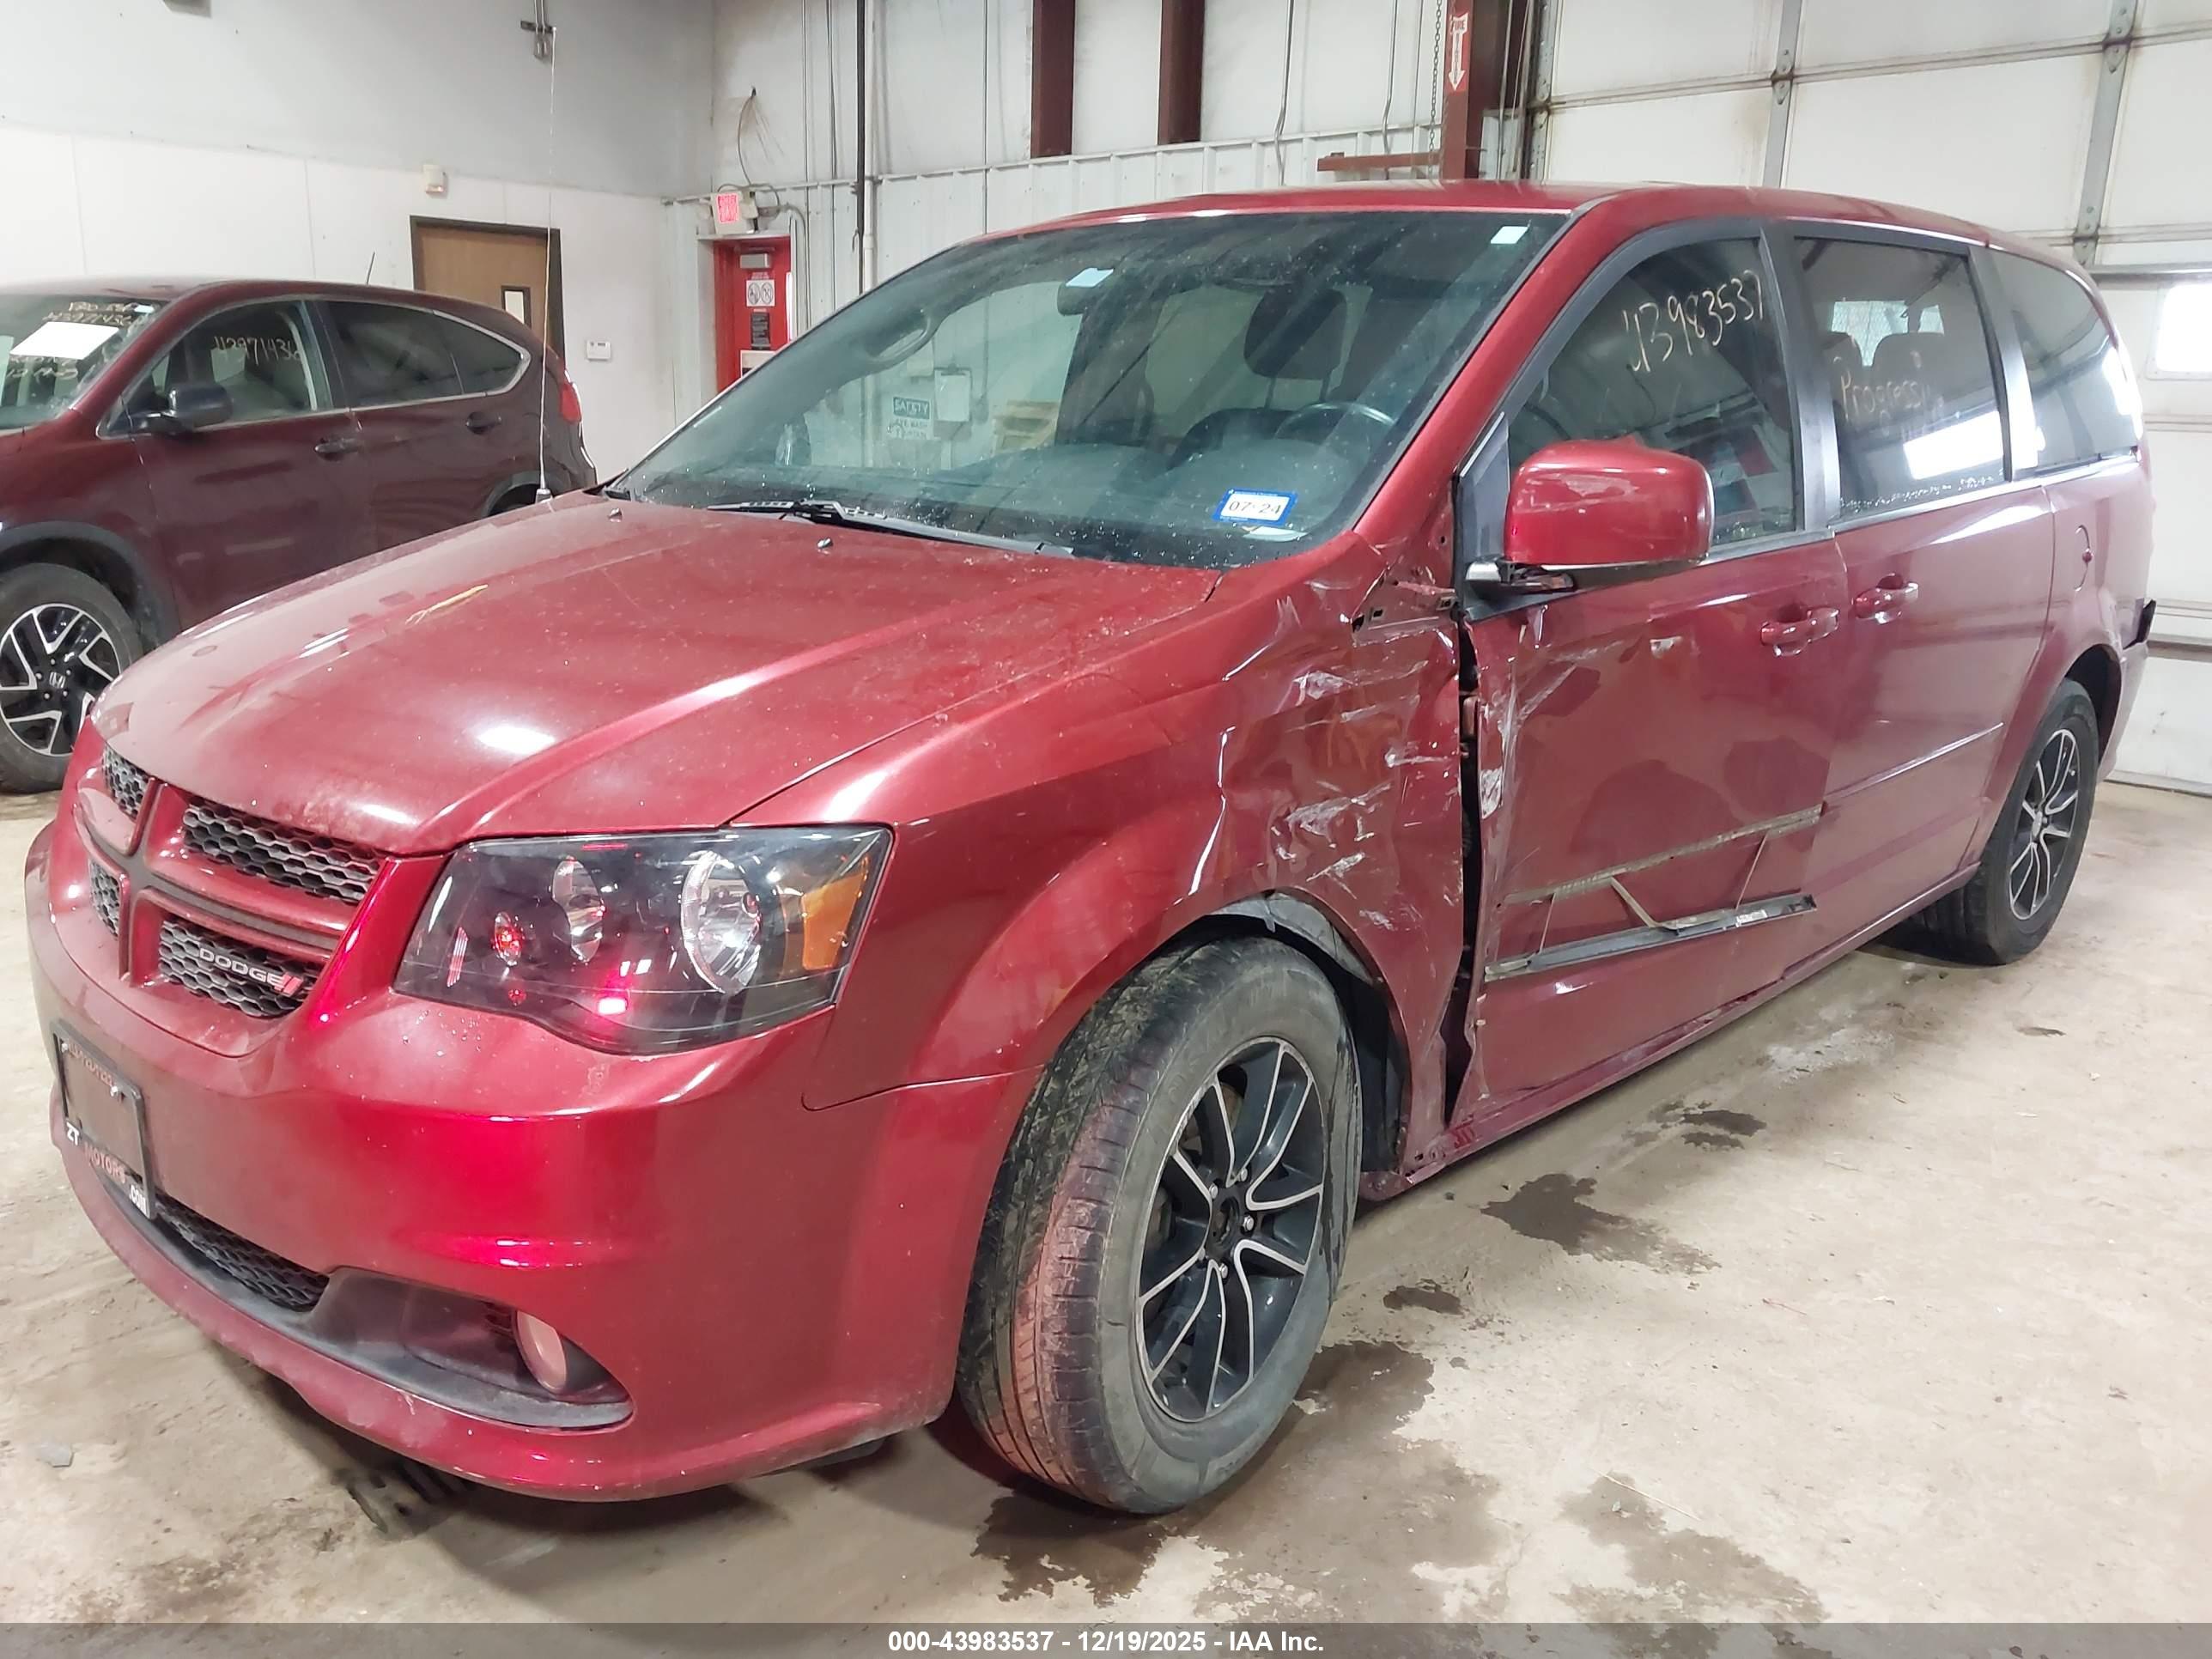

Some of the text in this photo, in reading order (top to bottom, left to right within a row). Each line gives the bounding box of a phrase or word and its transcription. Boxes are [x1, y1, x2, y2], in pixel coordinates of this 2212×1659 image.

[1622, 269, 1764, 374] 43983537
[199, 947, 286, 985] DODGE
[65, 1121, 80, 1146] ZT
[84, 1142, 127, 1184] MOTORS
